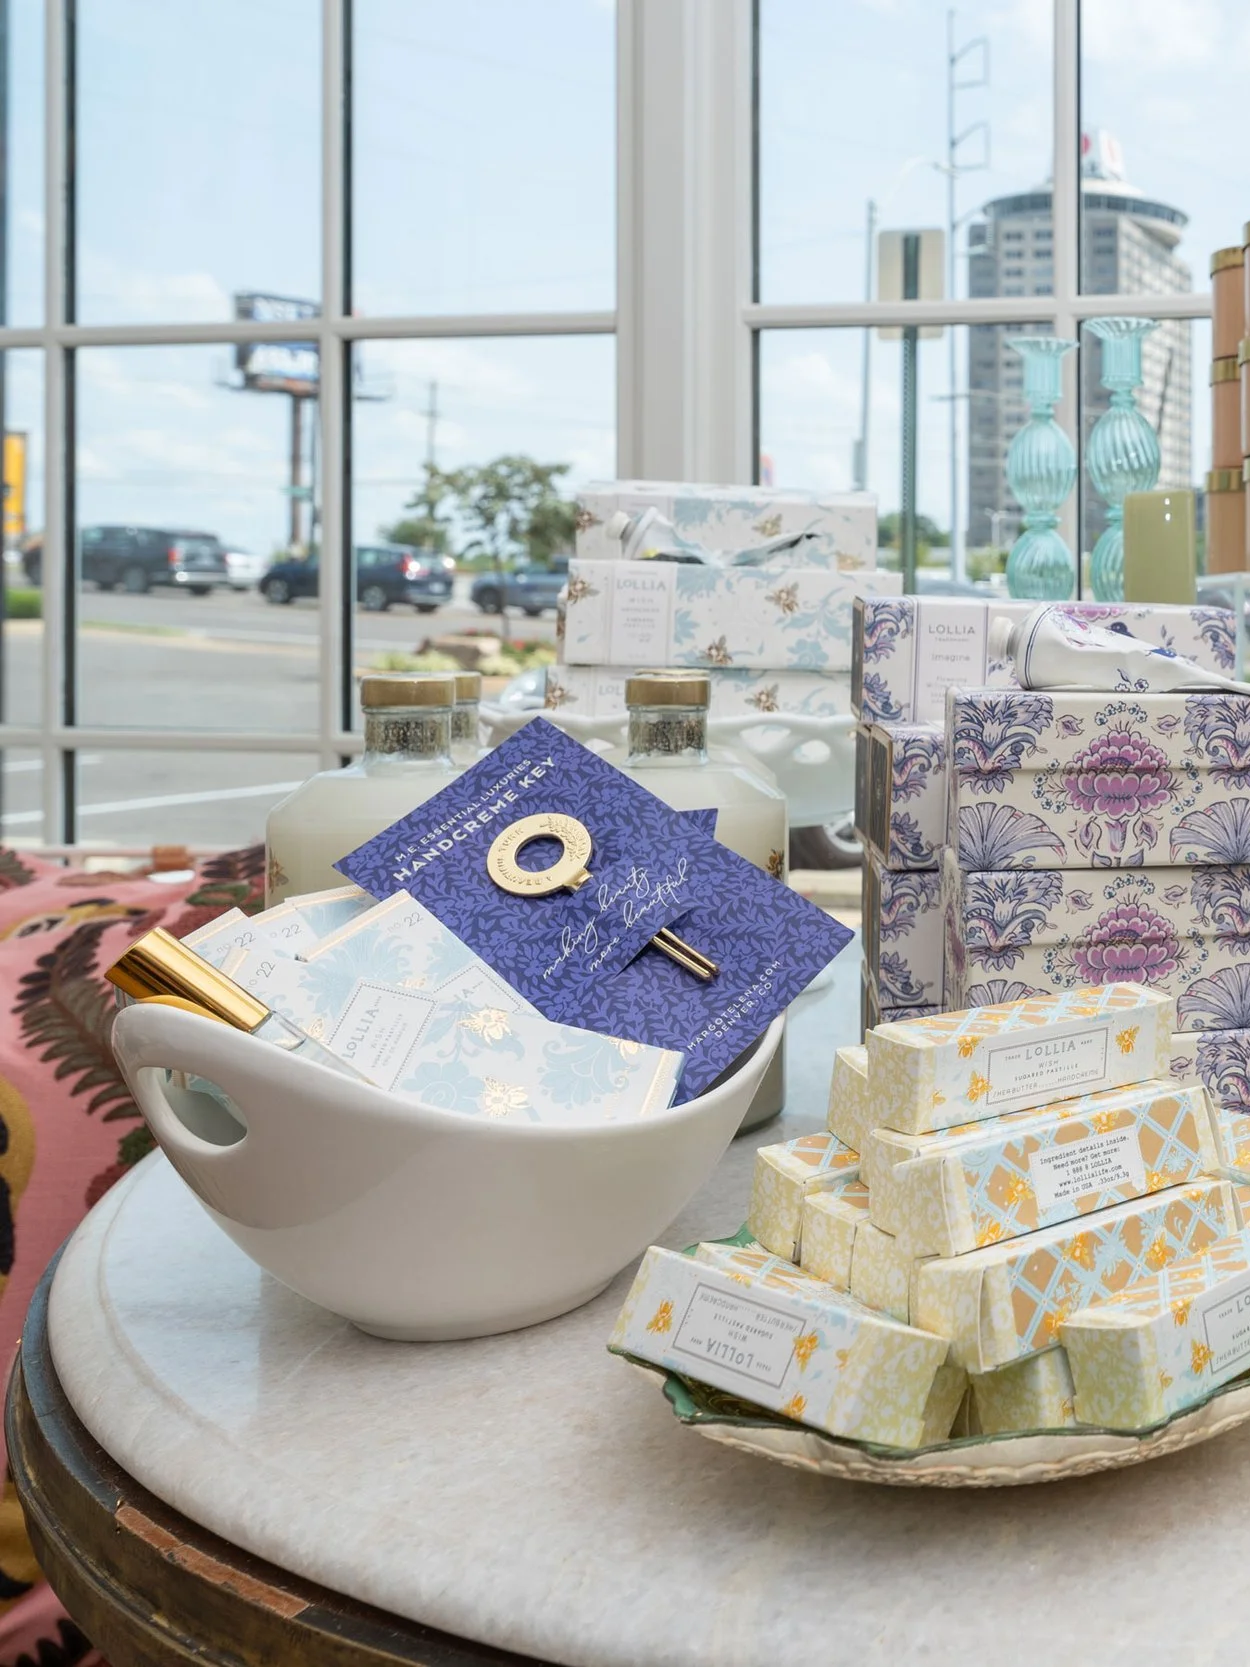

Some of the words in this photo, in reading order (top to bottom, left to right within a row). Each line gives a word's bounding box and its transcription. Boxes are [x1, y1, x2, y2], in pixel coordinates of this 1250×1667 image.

[616, 579, 667, 591] LOLLIA
[928, 624, 976, 635] LOLLIA
[421, 802, 481, 845] ESSENTIAL
[480, 759, 531, 801] LUXURIES
[393, 789, 519, 881] HANDCREME
[518, 756, 555, 788] KEY
[404, 911, 424, 927] 22
[543, 917, 598, 979] making
[598, 866, 650, 913] beauty
[589, 937, 620, 973] more
[623, 857, 688, 930] beautiful
[234, 932, 256, 947] 22
[281, 924, 302, 938] 22
[256, 961, 276, 978] 22
[758, 982, 772, 996] CO
[687, 960, 781, 1051] MARGOTELENA.COM
[341, 1008, 380, 1059] LOLLIA
[1025, 1039, 1076, 1060] LOLLIA
[1015, 1070, 1043, 1081] SUGARED
[1046, 1063, 1079, 1074] PASTILLE
[1039, 1060, 1059, 1068] WISH
[1040, 1150, 1077, 1165] Ingredient
[1079, 1142, 1104, 1153] details
[1106, 1136, 1130, 1146] inside.
[1053, 1161, 1069, 1170] Need
[1071, 1156, 1088, 1165] more?
[1090, 1152, 1101, 1160] Get
[1103, 1148, 1120, 1156] more:
[1091, 1158, 1112, 1168] LOLLIA
[1059, 1164, 1122, 1187] www.lollialife.com
[1054, 1189, 1070, 1198] Made
[1081, 1182, 1093, 1190] USA
[706, 1337, 754, 1368] LOLLIA
